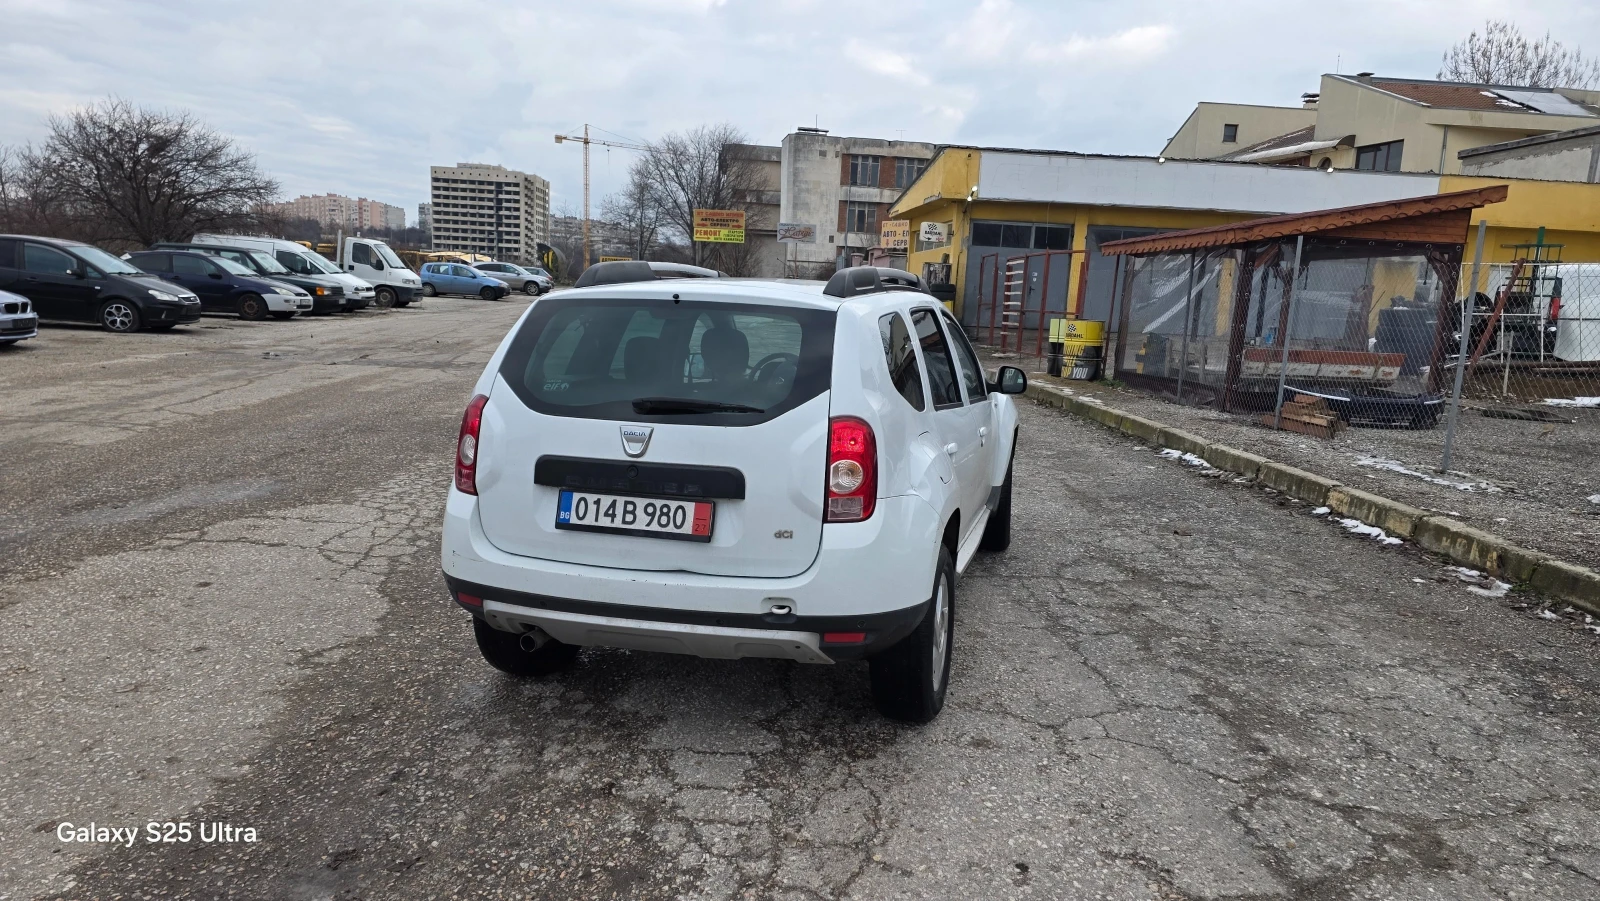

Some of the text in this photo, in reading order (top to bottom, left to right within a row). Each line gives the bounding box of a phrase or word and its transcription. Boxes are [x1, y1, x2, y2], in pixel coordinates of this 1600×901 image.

[695, 229, 721, 237] РЕМОНТ
[882, 230, 897, 238] АВТО
[1072, 367, 1089, 379] YOU
[543, 382, 560, 391] elf
[560, 511, 570, 519] BG
